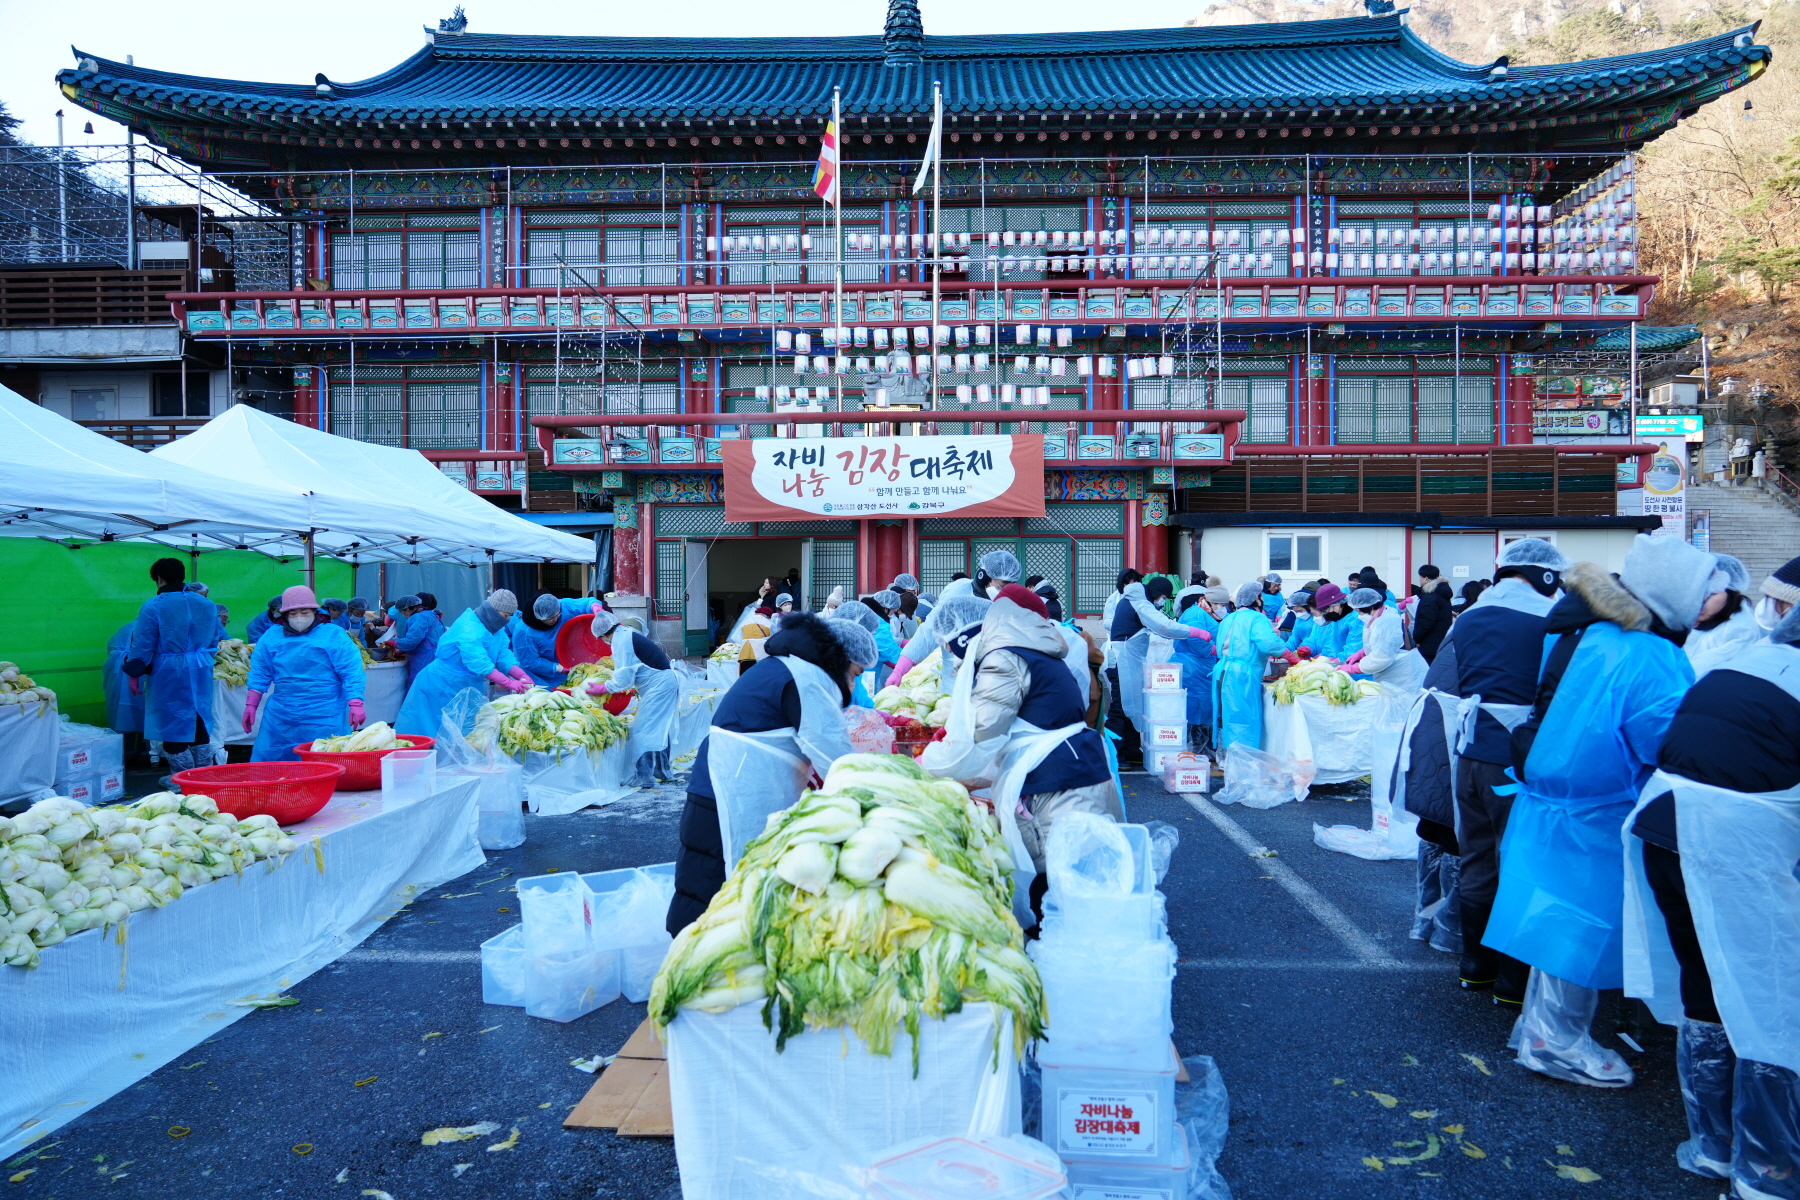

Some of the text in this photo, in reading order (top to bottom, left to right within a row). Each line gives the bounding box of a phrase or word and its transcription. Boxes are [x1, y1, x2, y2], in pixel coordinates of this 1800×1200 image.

[1589, 415, 1598, 427] 행
[772, 443, 993, 486] 자비 김장 대축제
[782, 468, 830, 498] 나눔
[895, 486, 920, 497] 만들고
[922, 485, 939, 496] 함께
[1644, 496, 1660, 504] 도선사
[857, 503, 876, 511] 삼각산
[1644, 504, 1683, 513] 땅 한 평 불사
[1081, 1104, 1133, 1119] 자비나눔
[1074, 1118, 1141, 1136] 김장대축제
